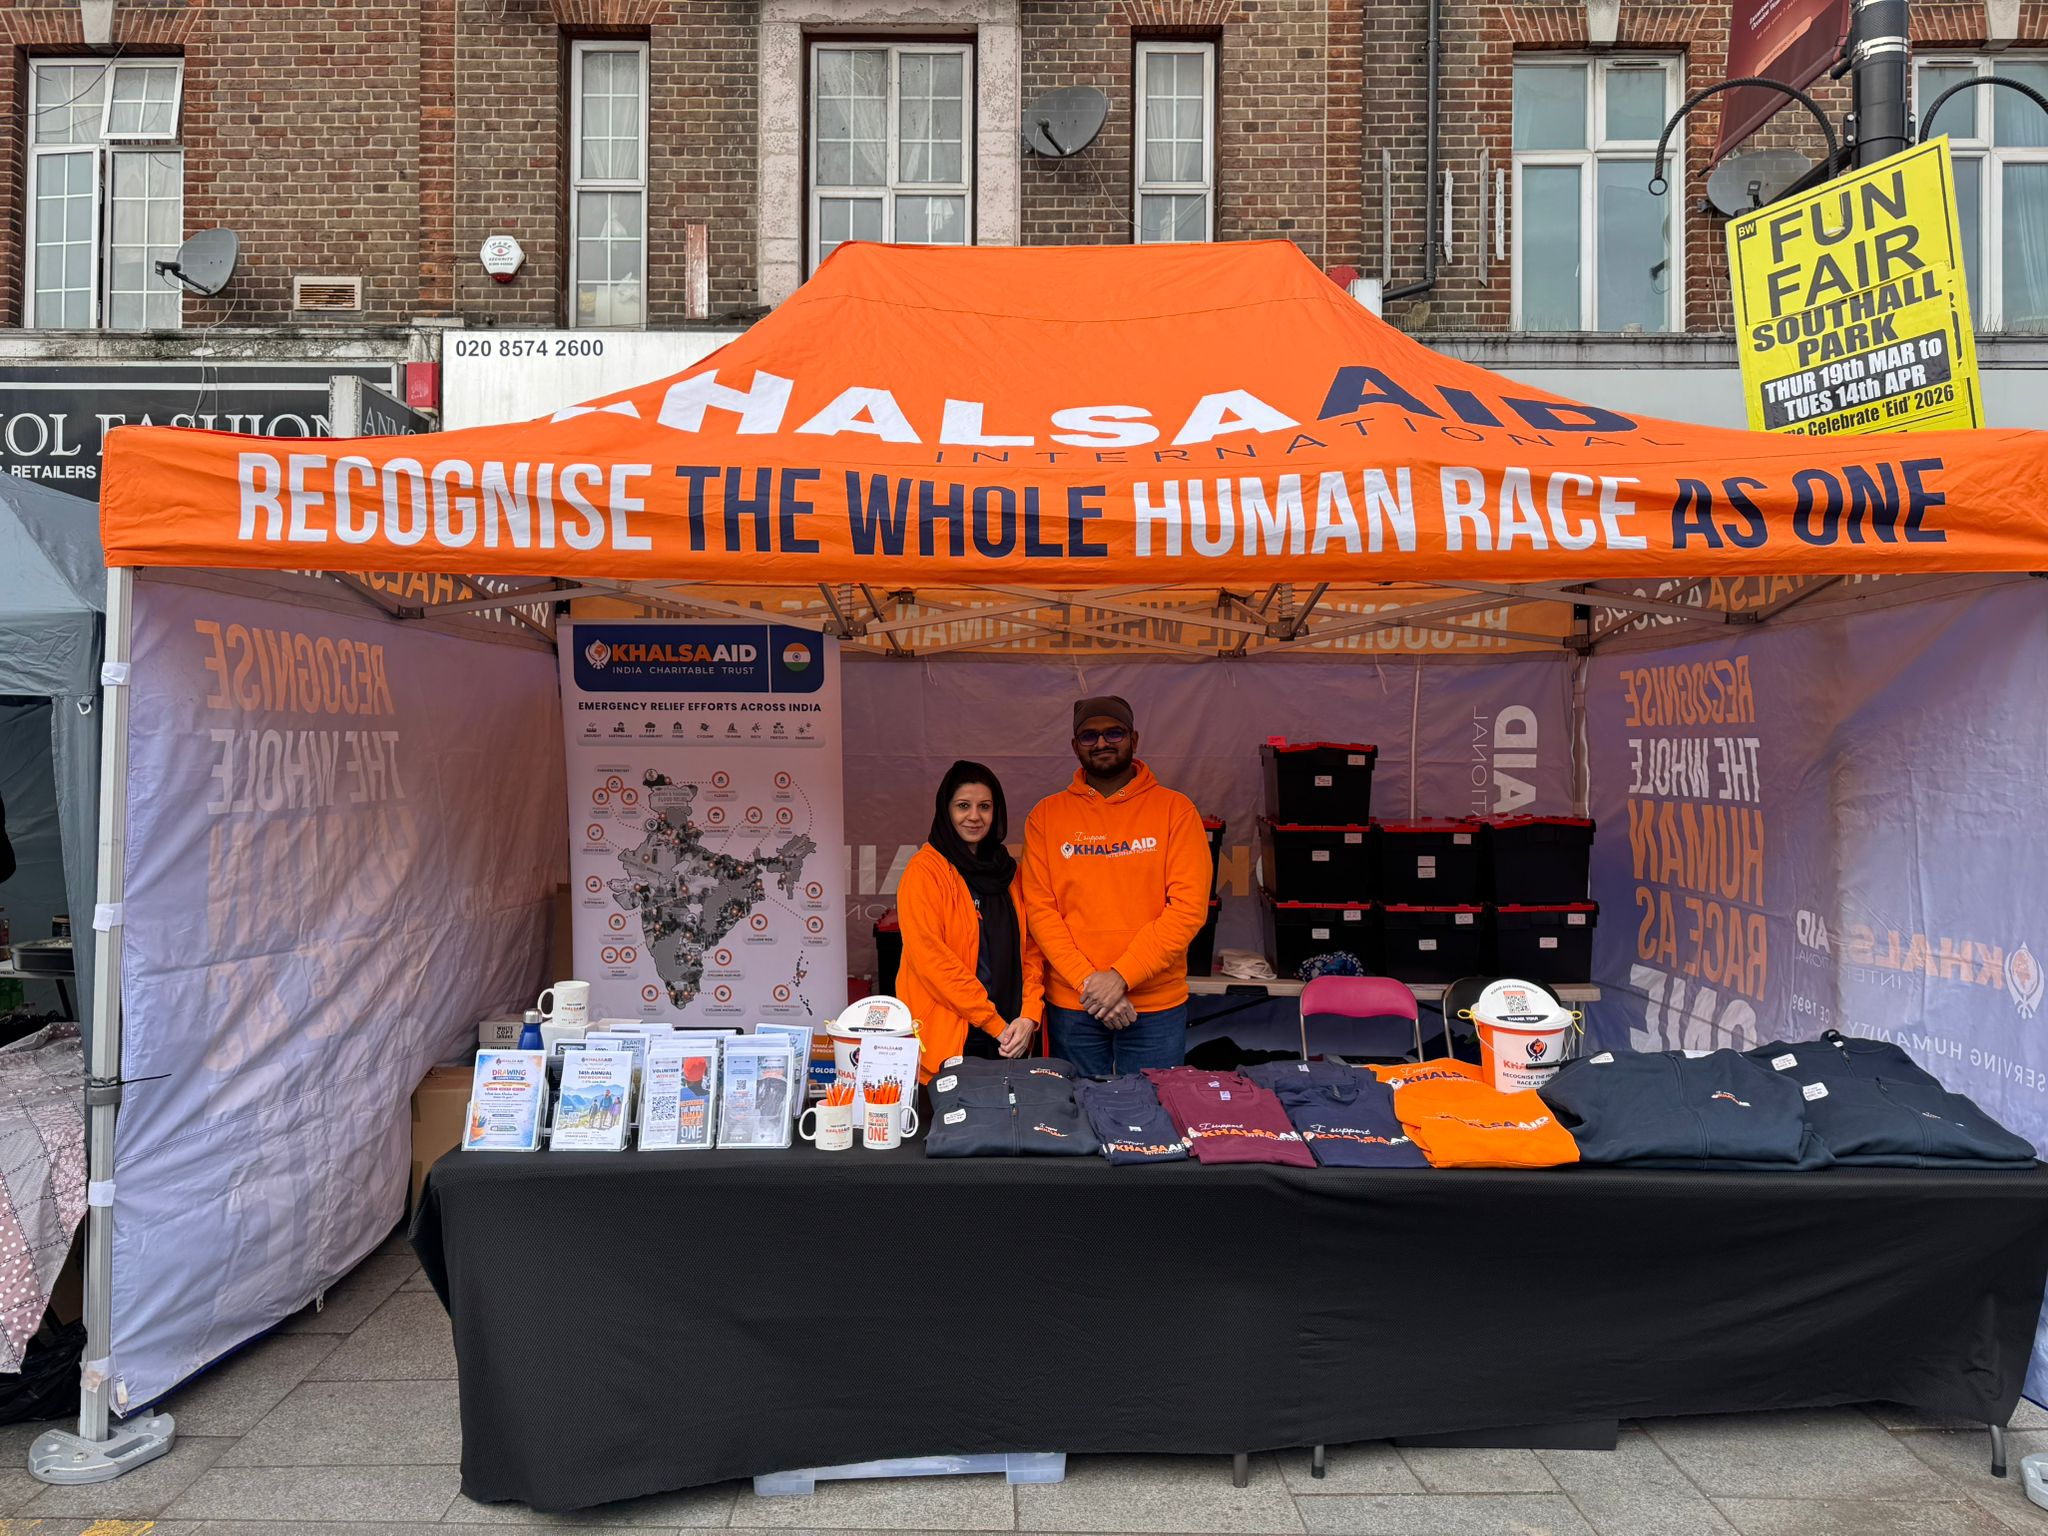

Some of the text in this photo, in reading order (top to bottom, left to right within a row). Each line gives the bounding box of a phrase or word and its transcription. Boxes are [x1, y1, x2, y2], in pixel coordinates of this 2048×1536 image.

[1738, 223, 1756, 238] BW
[1769, 170, 1908, 264] FUN
[1767, 225, 1926, 318] FAIR
[1752, 269, 1943, 352] SOUTHALL
[455, 340, 604, 357] 020 8574 2600
[1798, 313, 1900, 367] PARK
[1765, 337, 1943, 403] THUR 19th MAR to
[1784, 364, 1927, 422] TUES 14th APR
[1808, 404, 1879, 436] Celebrate
[1914, 384, 1954, 410] 2026
[0, 413, 82, 456] OL
[936, 417, 1685, 463] INTERNATIONAL
[11, 465, 96, 480] RETAILERS
[237, 452, 1947, 558] RECOGNISE THE WHOLE HUMAN RACE AS ONE
[612, 666, 755, 675] INDIA CHARITABLE TRUST
[578, 702, 822, 712] EMERGENCY RELIEF EFFORTS ACROSS INDIA
[1502, 1072, 1534, 1080] RECOGNISE
[681, 1126, 703, 1140] ONE
[868, 1126, 889, 1142] ONE
[1330, 1126, 1372, 1136] support
